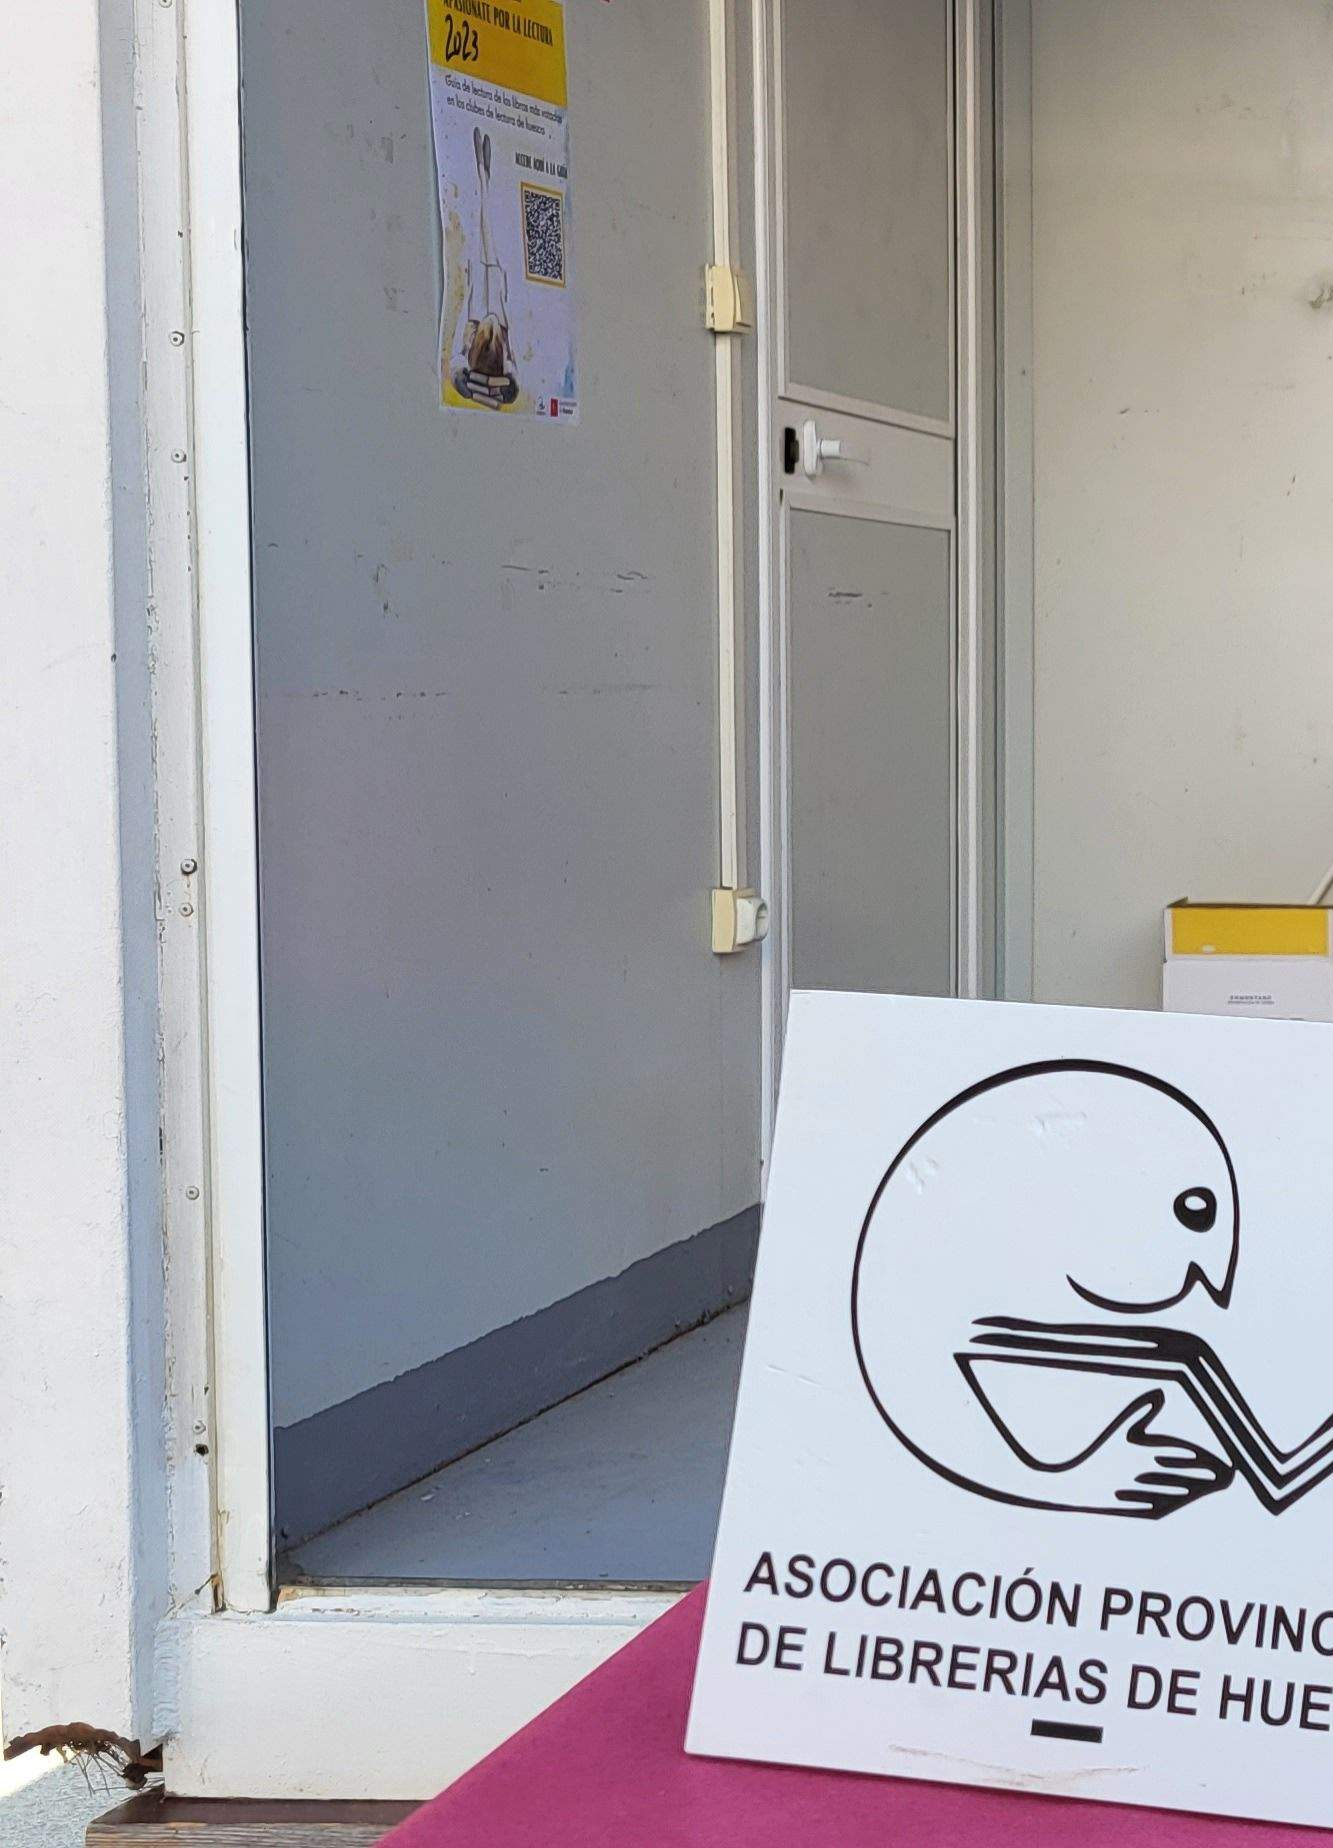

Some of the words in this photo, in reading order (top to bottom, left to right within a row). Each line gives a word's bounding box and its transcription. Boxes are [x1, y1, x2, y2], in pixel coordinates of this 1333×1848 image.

[445, 13, 479, 62] 2023
[493, 7, 511, 31] POR
[512, 14, 521, 35] LA
[523, 19, 554, 46] LECTURA
[743, 1552, 1081, 1628] ASOCIACIÓN
[736, 1622, 807, 1671] DE
[823, 1631, 1108, 1705] LIBRERIAS
[1127, 1664, 1201, 1716] DE
